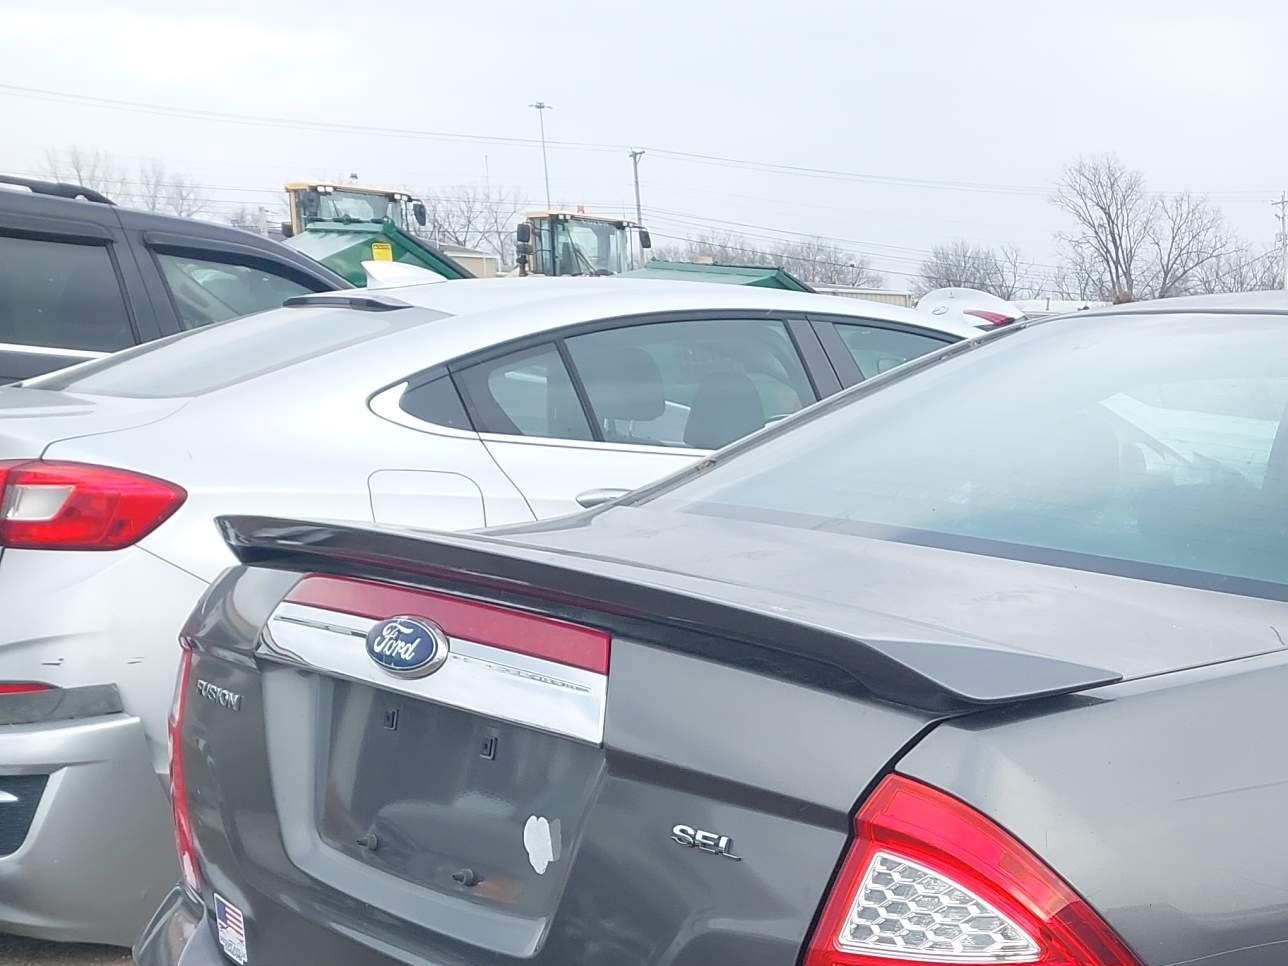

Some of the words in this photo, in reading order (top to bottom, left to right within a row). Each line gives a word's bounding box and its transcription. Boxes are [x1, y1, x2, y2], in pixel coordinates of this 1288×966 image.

[373, 622, 421, 660] Ford
[197, 679, 241, 711] FUSION
[671, 824, 743, 860] SEL
